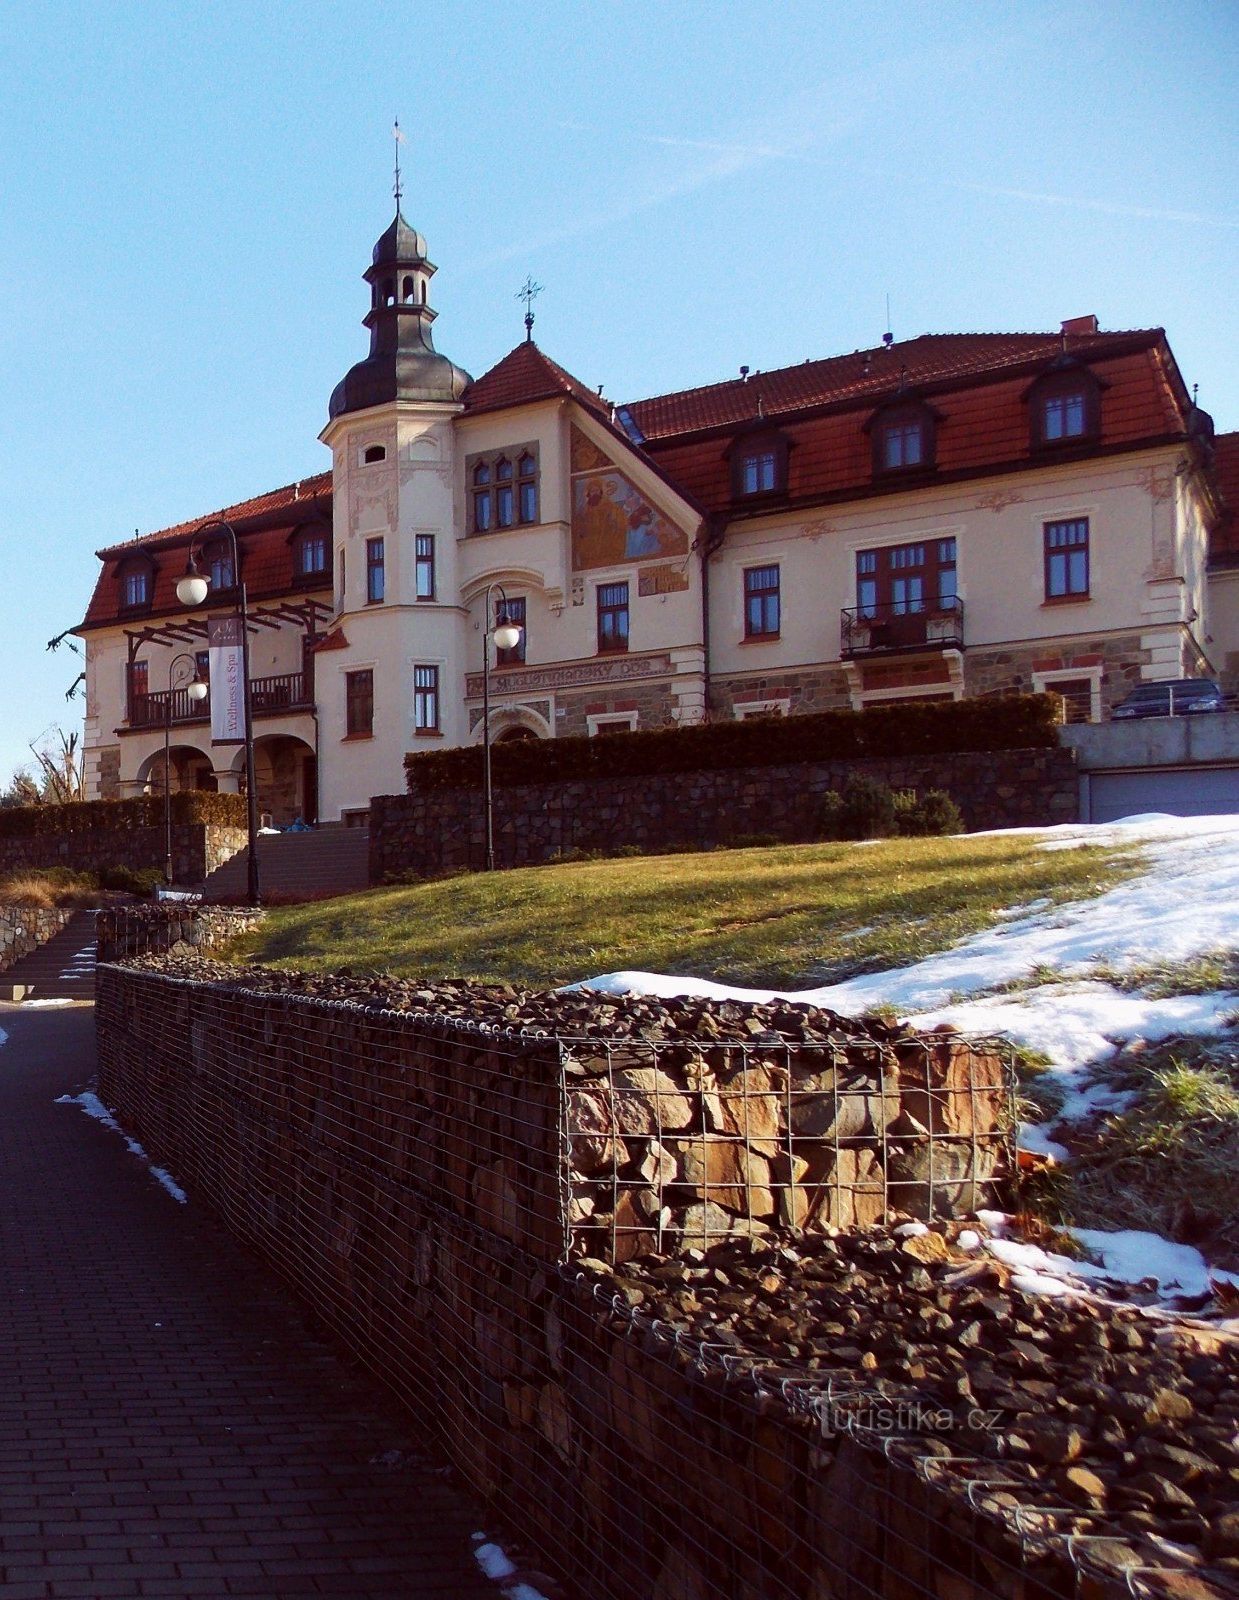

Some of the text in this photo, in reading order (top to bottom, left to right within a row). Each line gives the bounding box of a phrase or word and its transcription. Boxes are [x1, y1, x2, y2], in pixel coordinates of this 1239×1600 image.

[227, 654, 238, 732] Wellness & Spa
